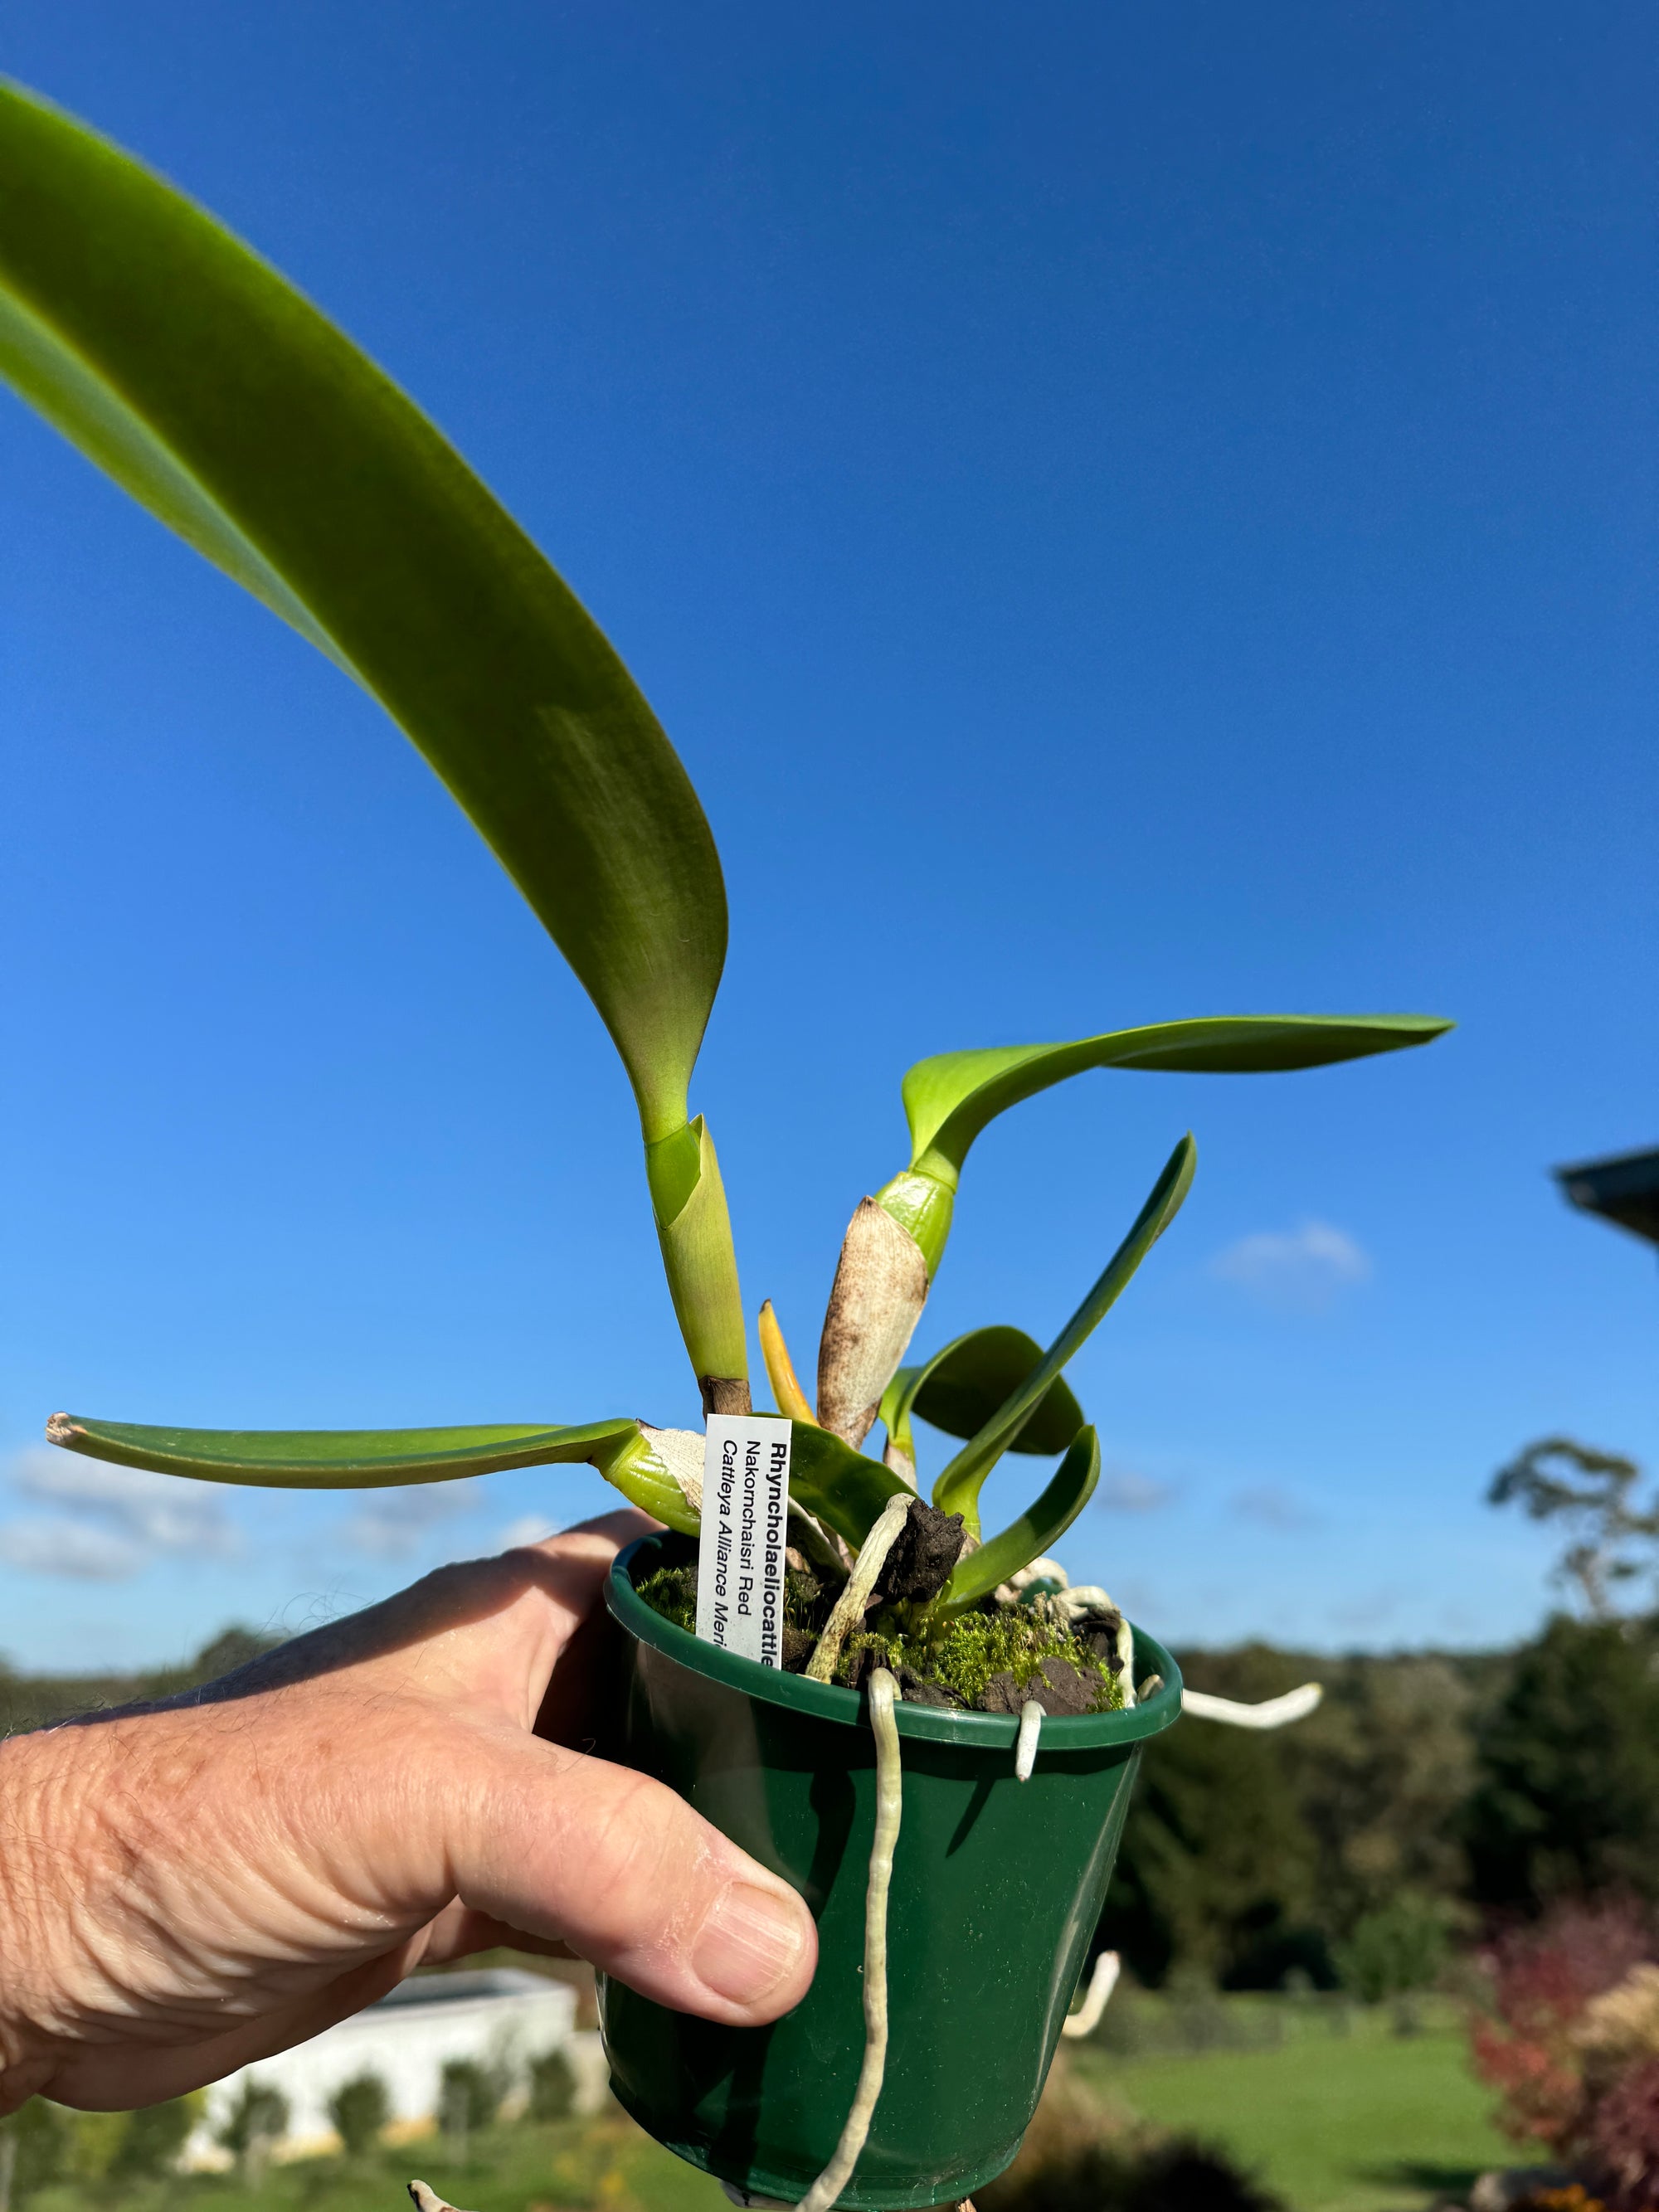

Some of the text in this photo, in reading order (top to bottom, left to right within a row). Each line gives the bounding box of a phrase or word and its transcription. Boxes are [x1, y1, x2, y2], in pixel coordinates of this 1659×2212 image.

[713, 1440, 737, 1648] Cattleya Alliance Meri
[738, 1441, 761, 1616] Nakornchaisri Red
